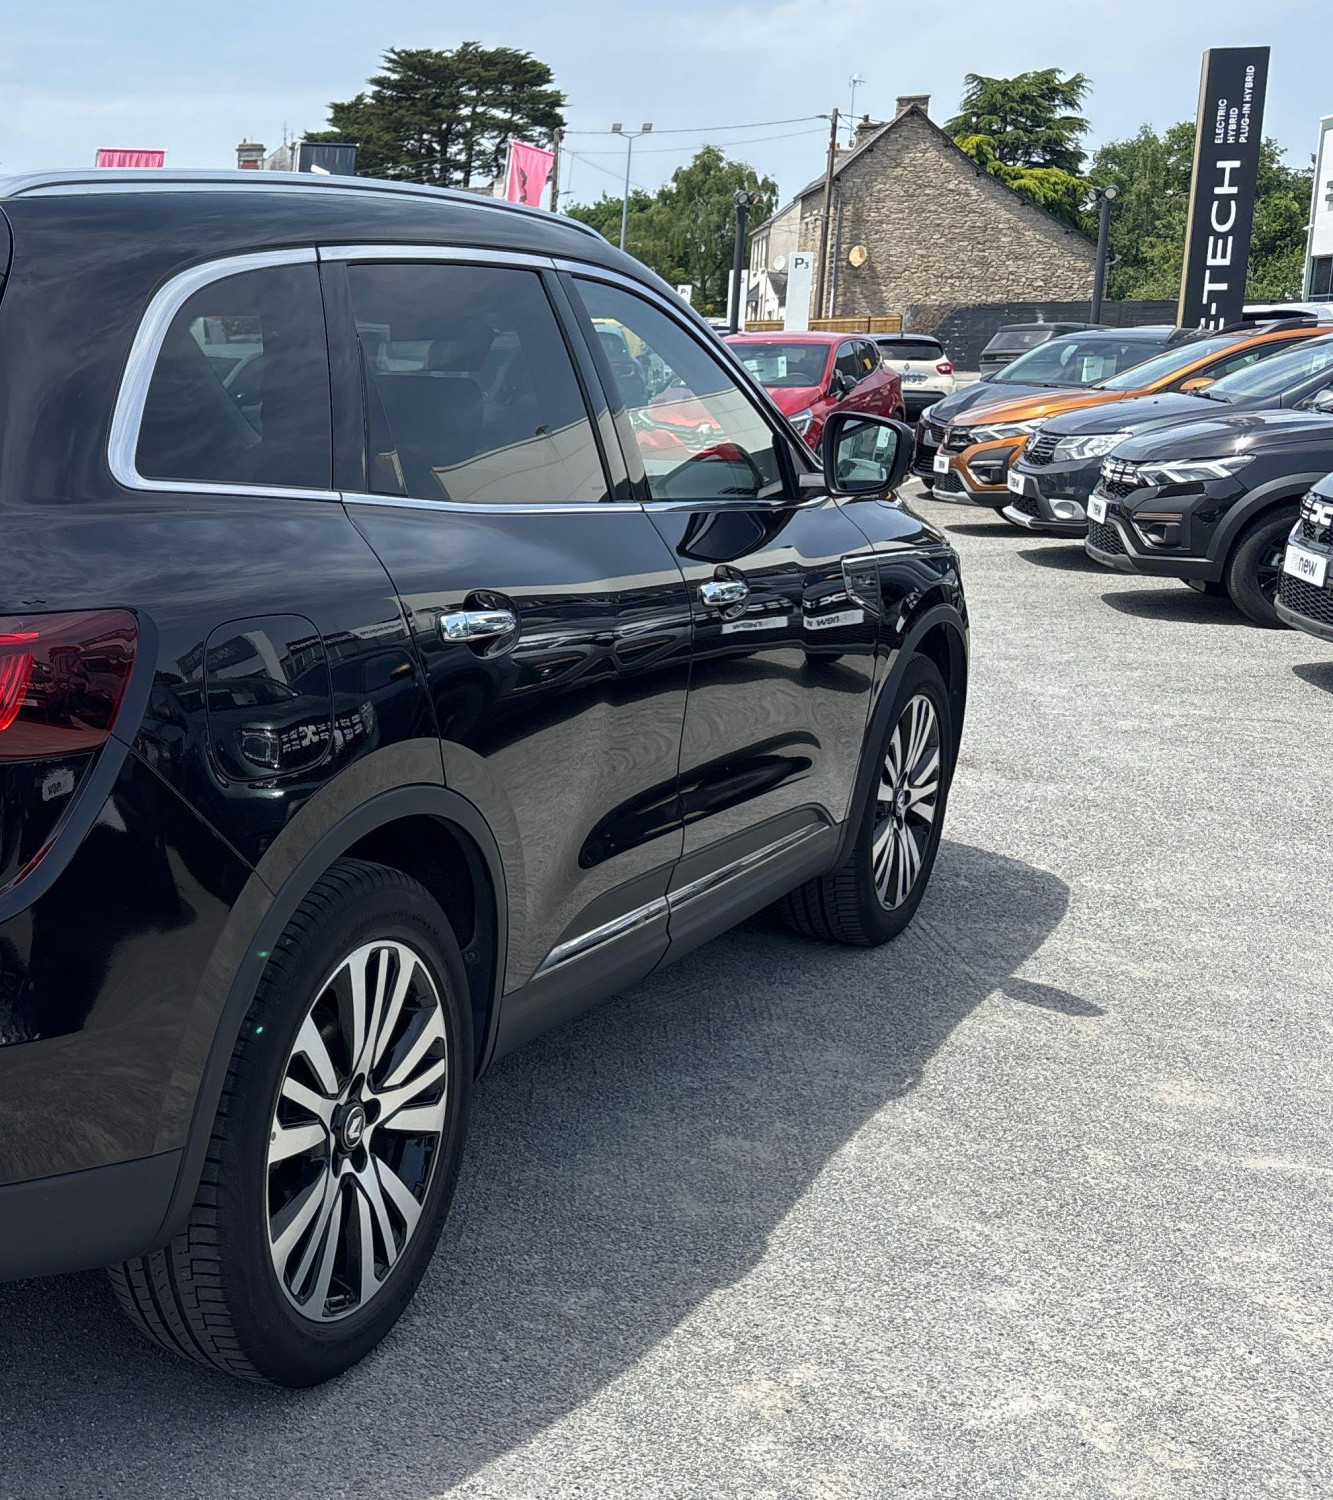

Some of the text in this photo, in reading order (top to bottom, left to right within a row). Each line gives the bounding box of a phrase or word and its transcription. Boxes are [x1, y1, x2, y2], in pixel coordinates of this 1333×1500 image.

[1214, 98, 1228, 144] ELECTRIC
[1227, 107, 1239, 144] HYBRID
[1239, 64, 1255, 144] PLUG-IN HYBRID
